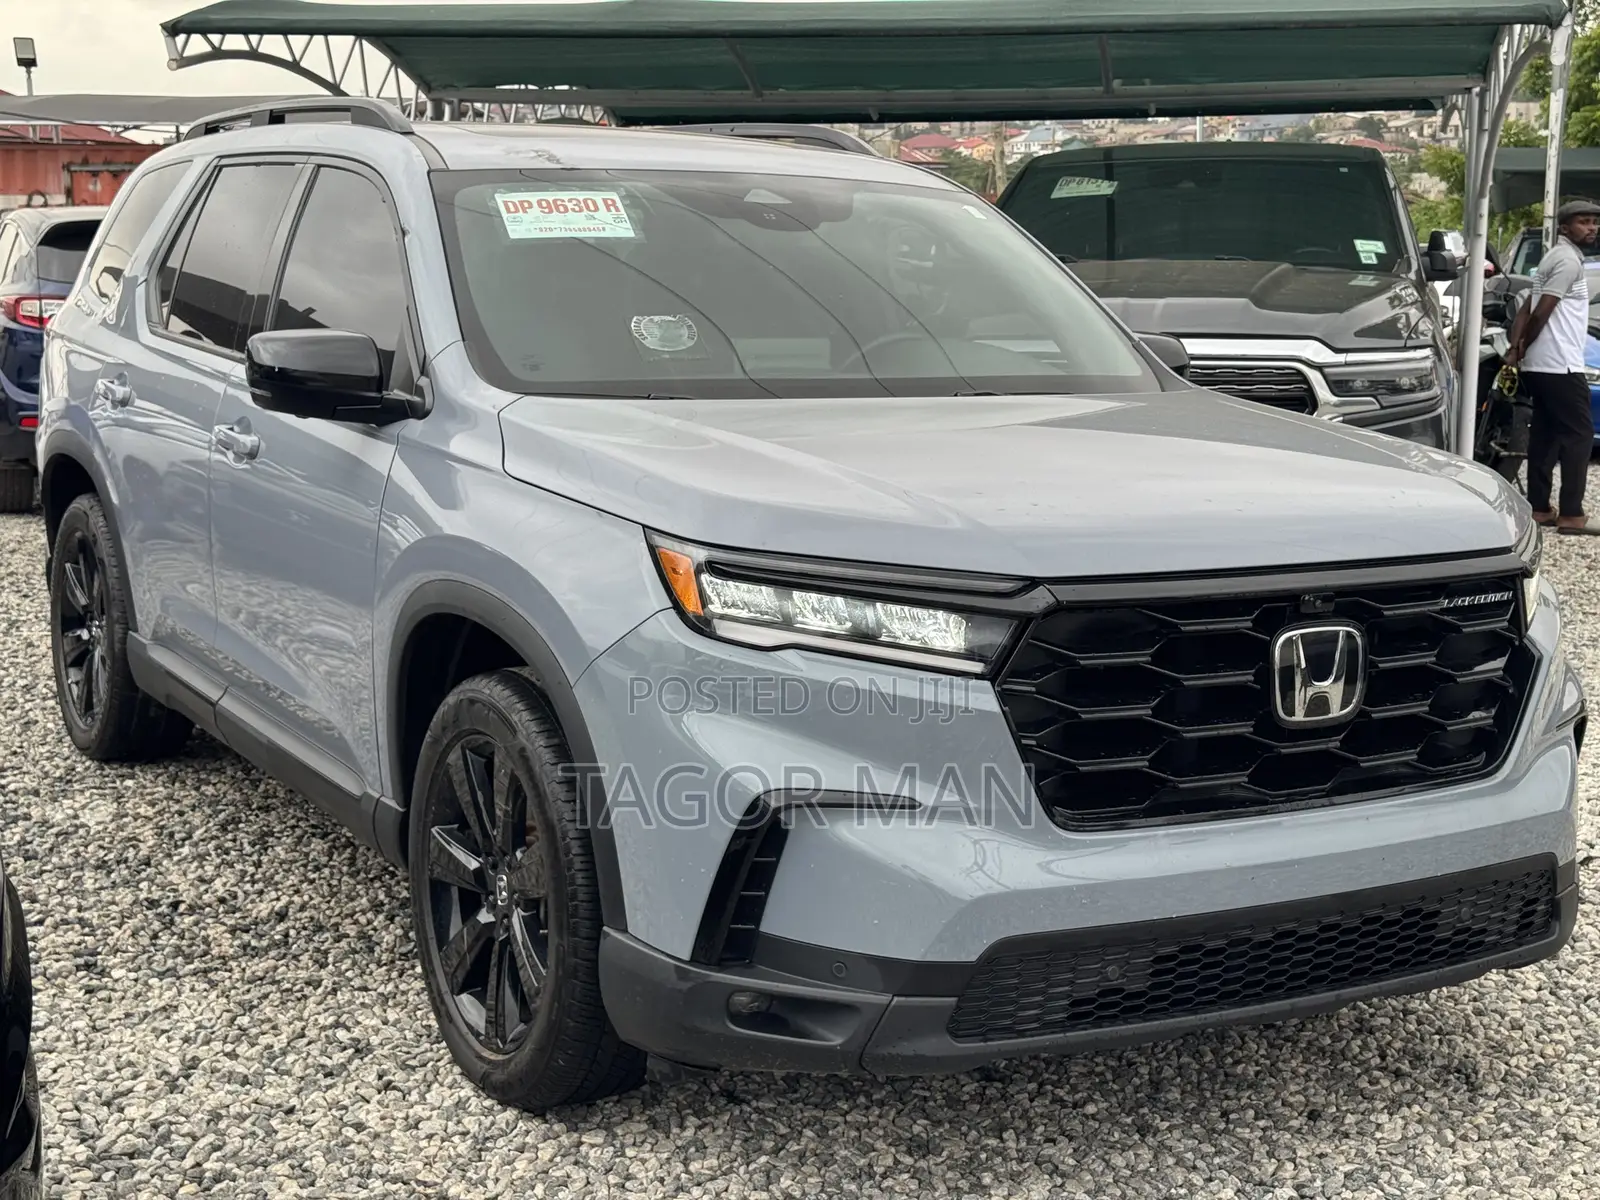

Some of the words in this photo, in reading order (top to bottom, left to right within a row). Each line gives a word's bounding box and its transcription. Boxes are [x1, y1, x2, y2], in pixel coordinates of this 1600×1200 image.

[502, 199, 533, 214] DP
[536, 198, 599, 214] 9630
[601, 198, 621, 213] R
